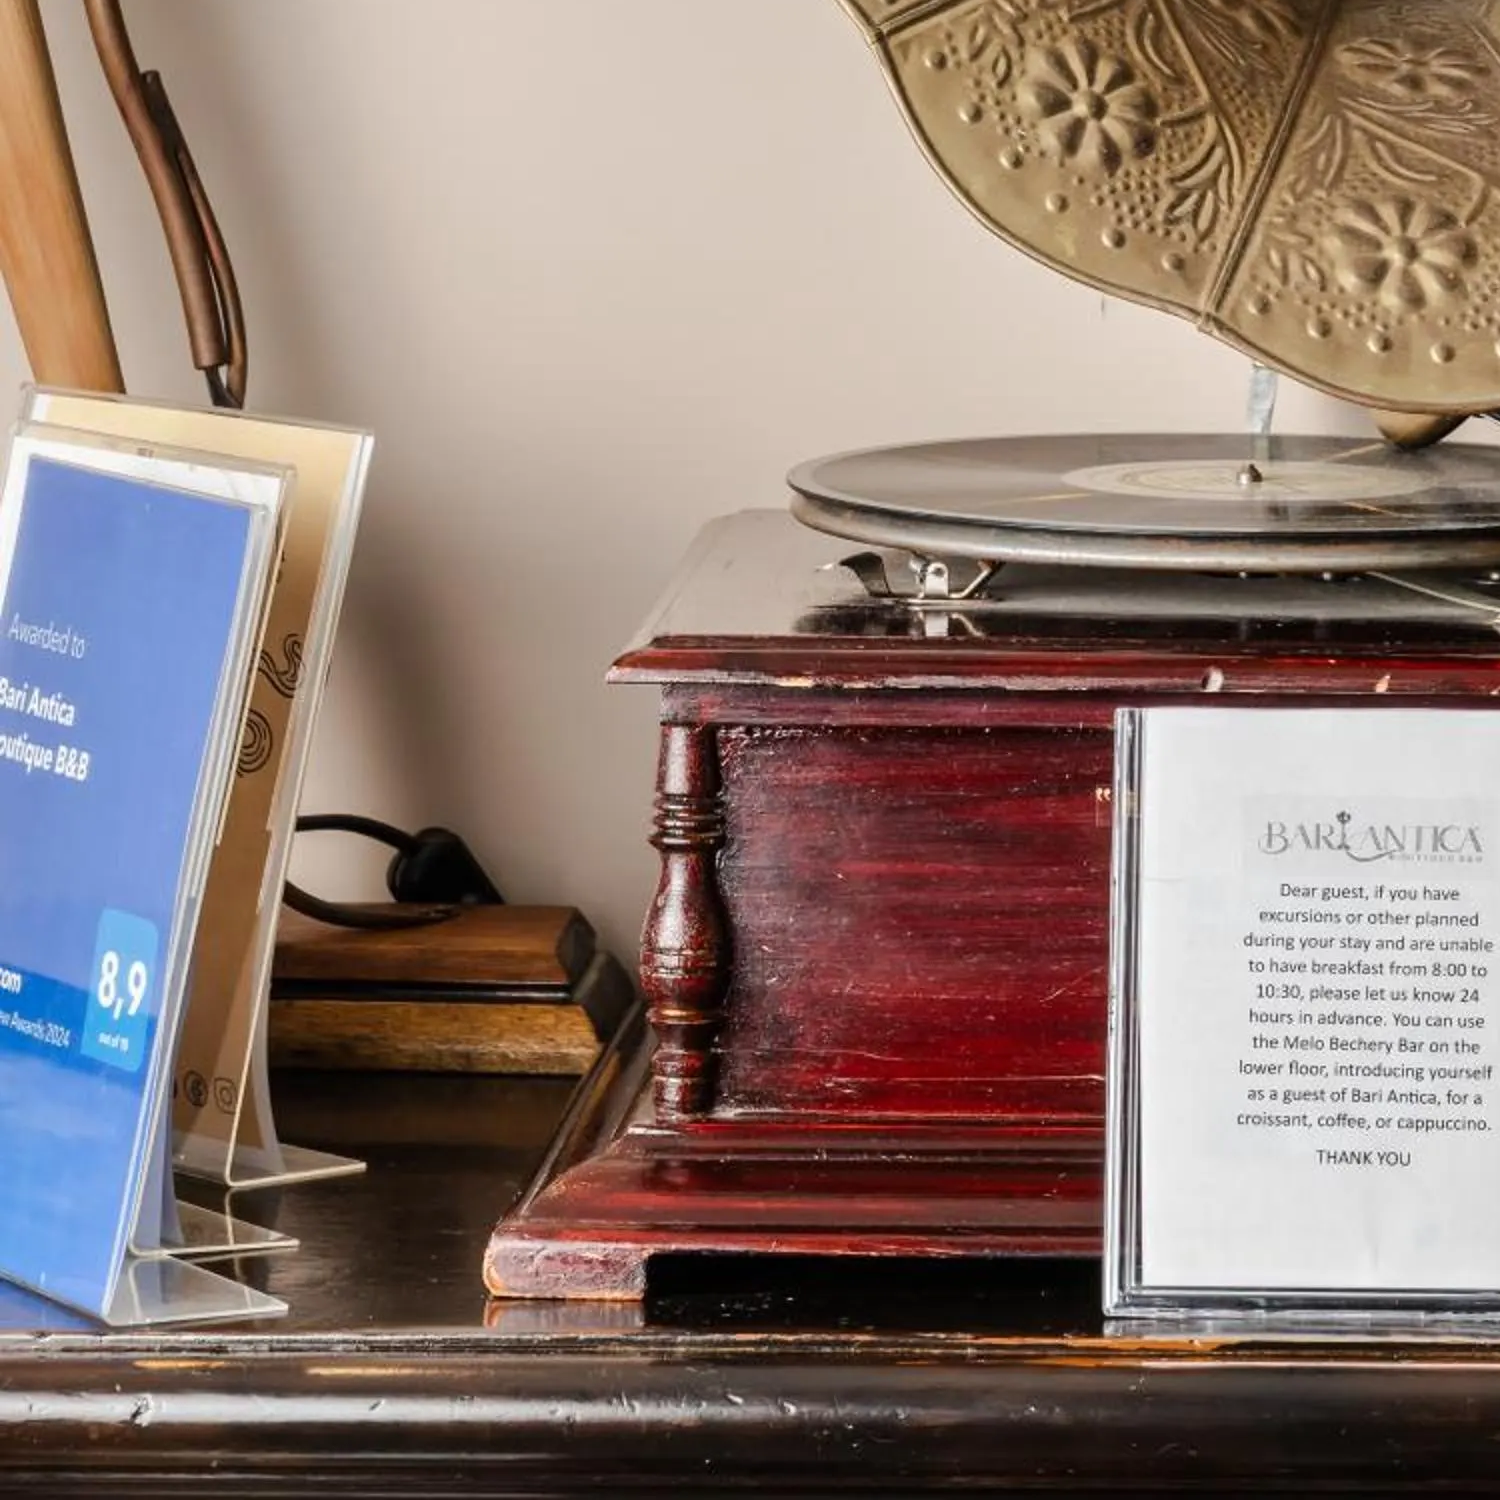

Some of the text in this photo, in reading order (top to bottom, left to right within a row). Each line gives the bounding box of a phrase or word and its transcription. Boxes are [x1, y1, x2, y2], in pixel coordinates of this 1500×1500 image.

[8, 612, 85, 659] Awarded to
[0, 676, 76, 726] Bari Antica
[54, 744, 90, 781] B&B
[1258, 810, 1483, 855] BARI ANTICA
[1280, 884, 1460, 901] Dear guest, if you have
[1259, 909, 1479, 928] excursions or other planned
[1243, 932, 1494, 952] during your stay and are unable
[1248, 959, 1487, 977] to have breakfast from 8:00 to
[98, 950, 147, 1020] 8,9
[1256, 984, 1480, 1003] 10:30, please let us know 24
[1249, 1009, 1485, 1028] hours in advance. You can use
[1252, 1036, 1481, 1054] the Melo Bechery Bar on the
[1239, 1060, 1493, 1081] lower floor, introducing yourself
[1248, 1088, 1483, 1106] as a guest of Bari Antica, for a
[1237, 1112, 1492, 1133] croissant, coffee, or cappuccino.
[1316, 1149, 1411, 1166] THANK YOU
